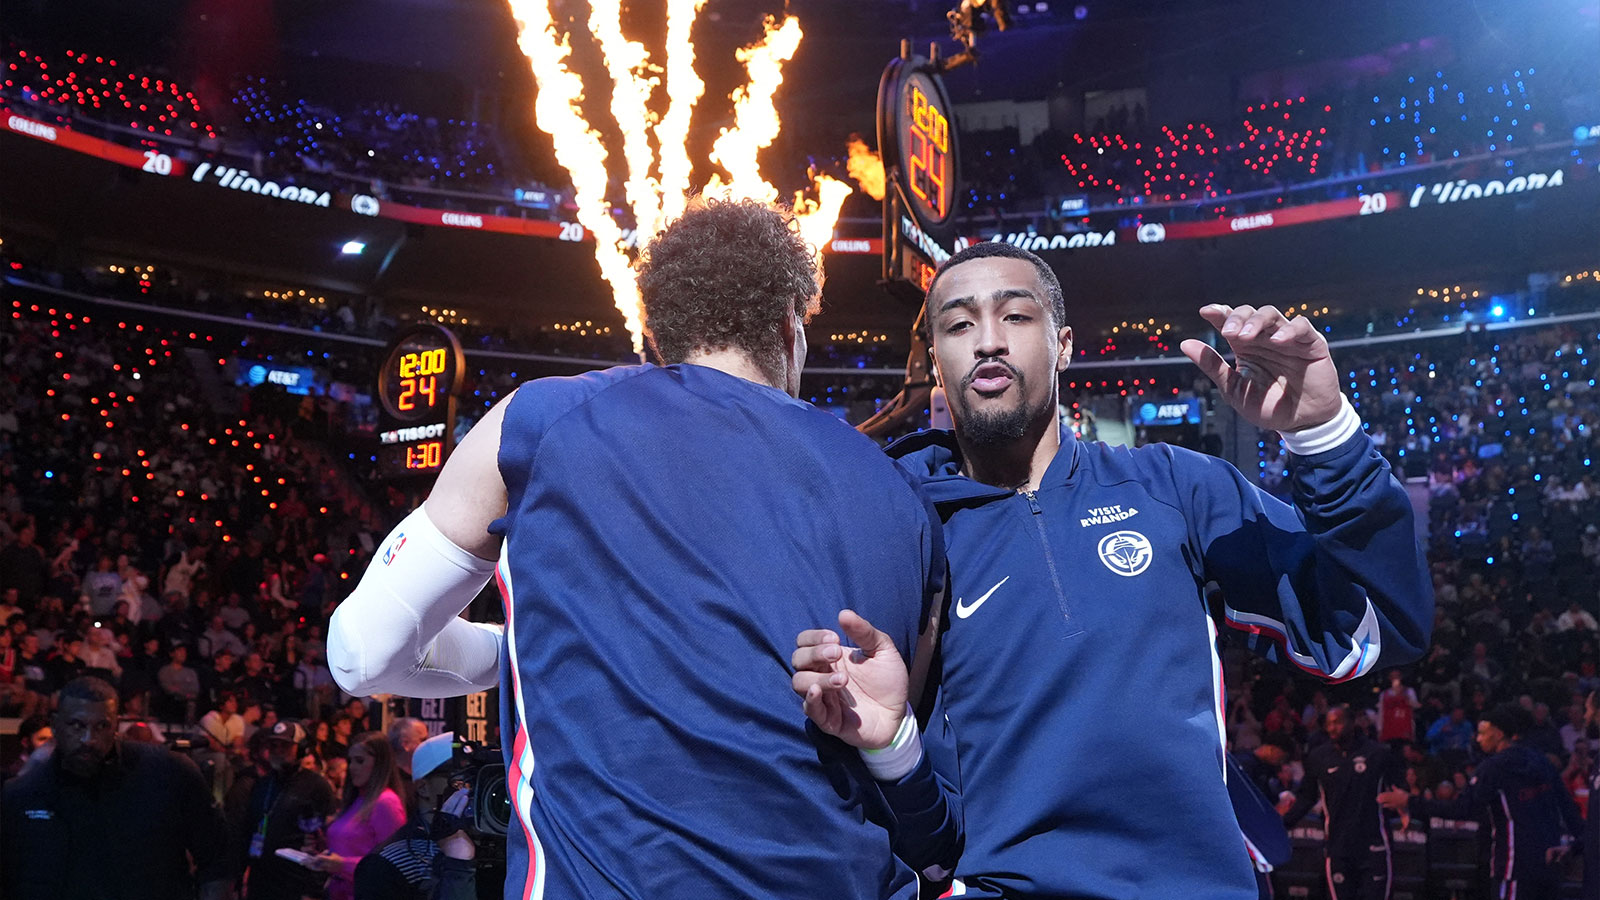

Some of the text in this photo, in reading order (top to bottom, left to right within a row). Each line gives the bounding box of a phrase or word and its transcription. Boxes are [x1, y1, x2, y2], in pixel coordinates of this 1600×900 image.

[7, 115, 58, 142] COLLINS
[142, 151, 173, 176] 20
[910, 124, 945, 218] 24
[1358, 192, 1387, 215] 20
[442, 212, 483, 229] COLLINS
[1231, 212, 1274, 231] COLLINS
[559, 222, 584, 242] 20
[832, 239, 870, 252] COLLINS
[399, 349, 446, 378] 12:00
[268, 370, 300, 386] AT&T
[398, 376, 437, 411] 24
[1158, 404, 1189, 418] AT&T
[398, 423, 446, 442] TISSOT
[406, 442, 442, 469] 1:30
[1080, 507, 1139, 528] RWANDA
[1088, 505, 1121, 517] VISIT
